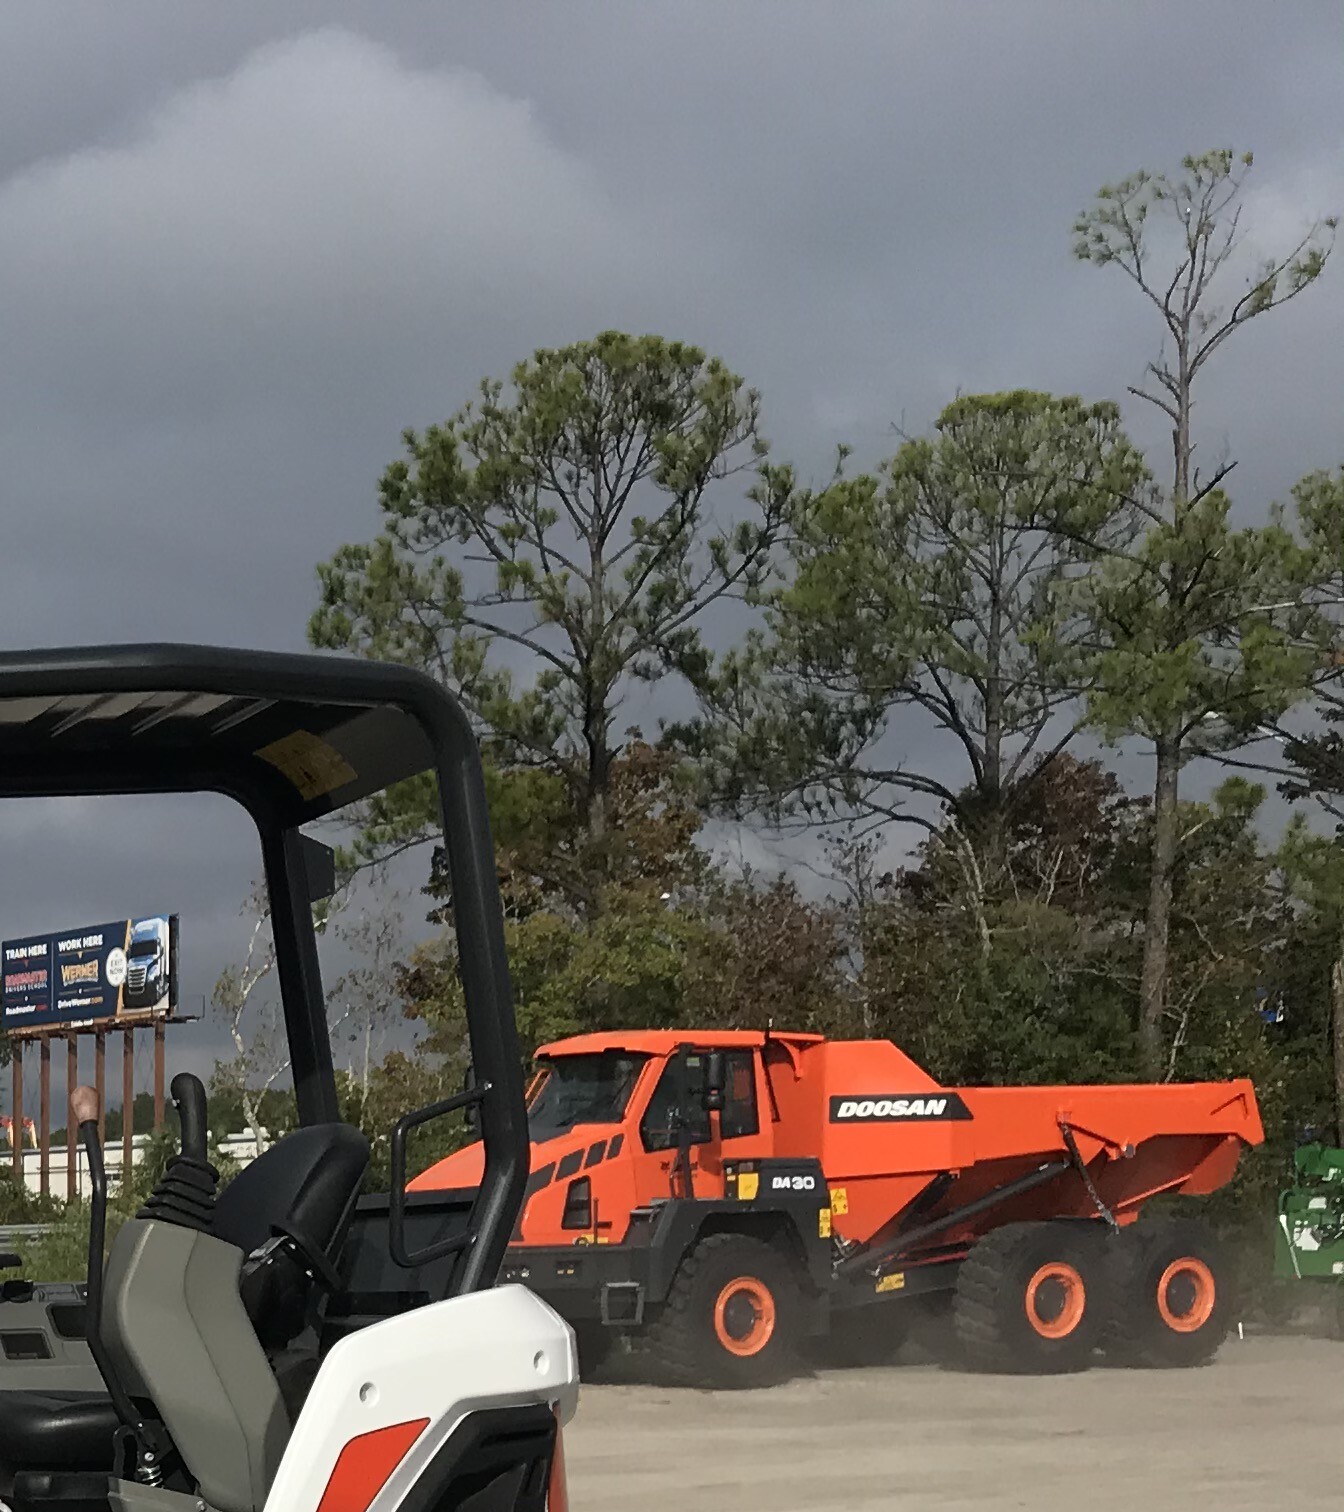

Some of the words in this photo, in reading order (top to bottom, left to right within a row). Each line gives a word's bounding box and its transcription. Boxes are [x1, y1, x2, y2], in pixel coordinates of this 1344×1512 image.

[58, 938, 82, 952] WORK
[83, 934, 103, 948] HERE
[837, 1099, 947, 1118] DOOSAN
[772, 1176, 815, 1190] DA30
